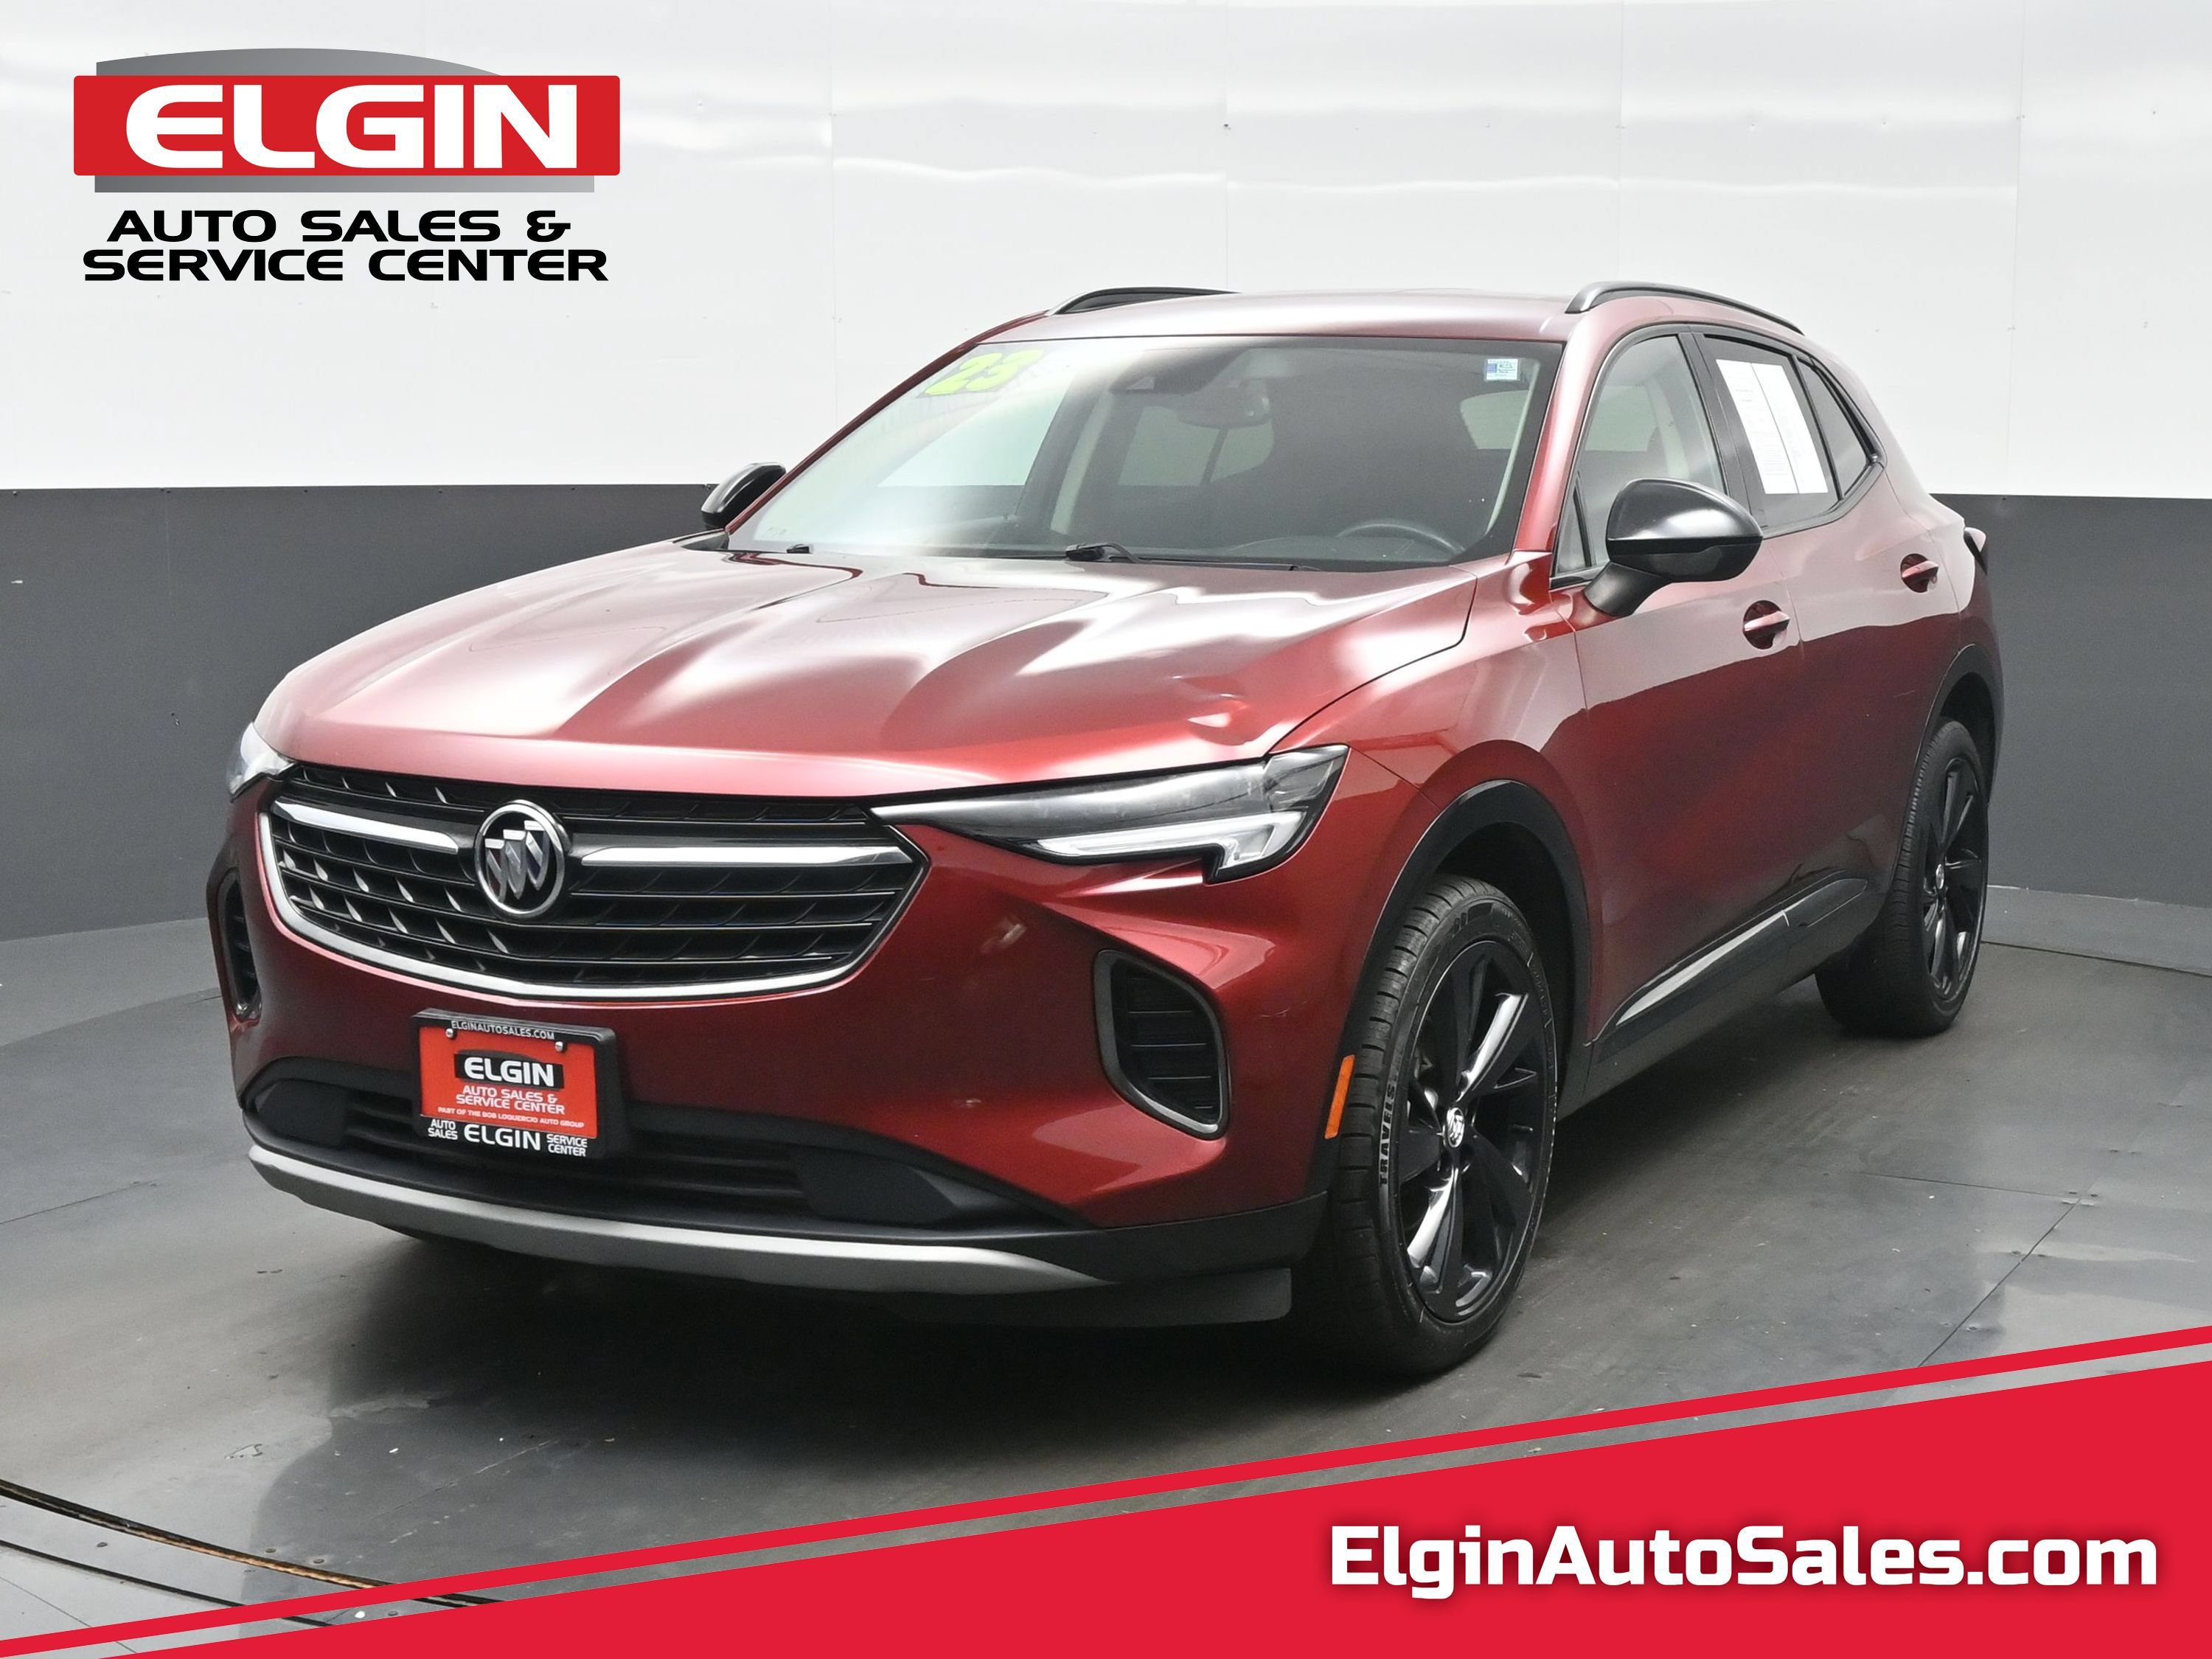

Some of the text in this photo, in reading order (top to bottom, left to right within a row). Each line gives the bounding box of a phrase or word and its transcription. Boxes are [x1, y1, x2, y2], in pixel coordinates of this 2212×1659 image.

[924, 349, 1044, 396] 23
[451, 1020, 555, 1040] ELGINAUTOSALES.COM
[464, 1056, 554, 1088] ELGIN
[456, 1094, 566, 1115] SERVICE CENTER
[462, 1085, 558, 1105] AUTO SALES &
[430, 1118, 456, 1130] AUTO
[540, 1118, 559, 1126] AUTO
[560, 1119, 585, 1128] GROUP
[428, 1127, 459, 1141] SALES
[463, 1123, 541, 1151] ELGIN
[546, 1134, 588, 1148] SERVICE
[548, 1144, 587, 1158] CENTER
